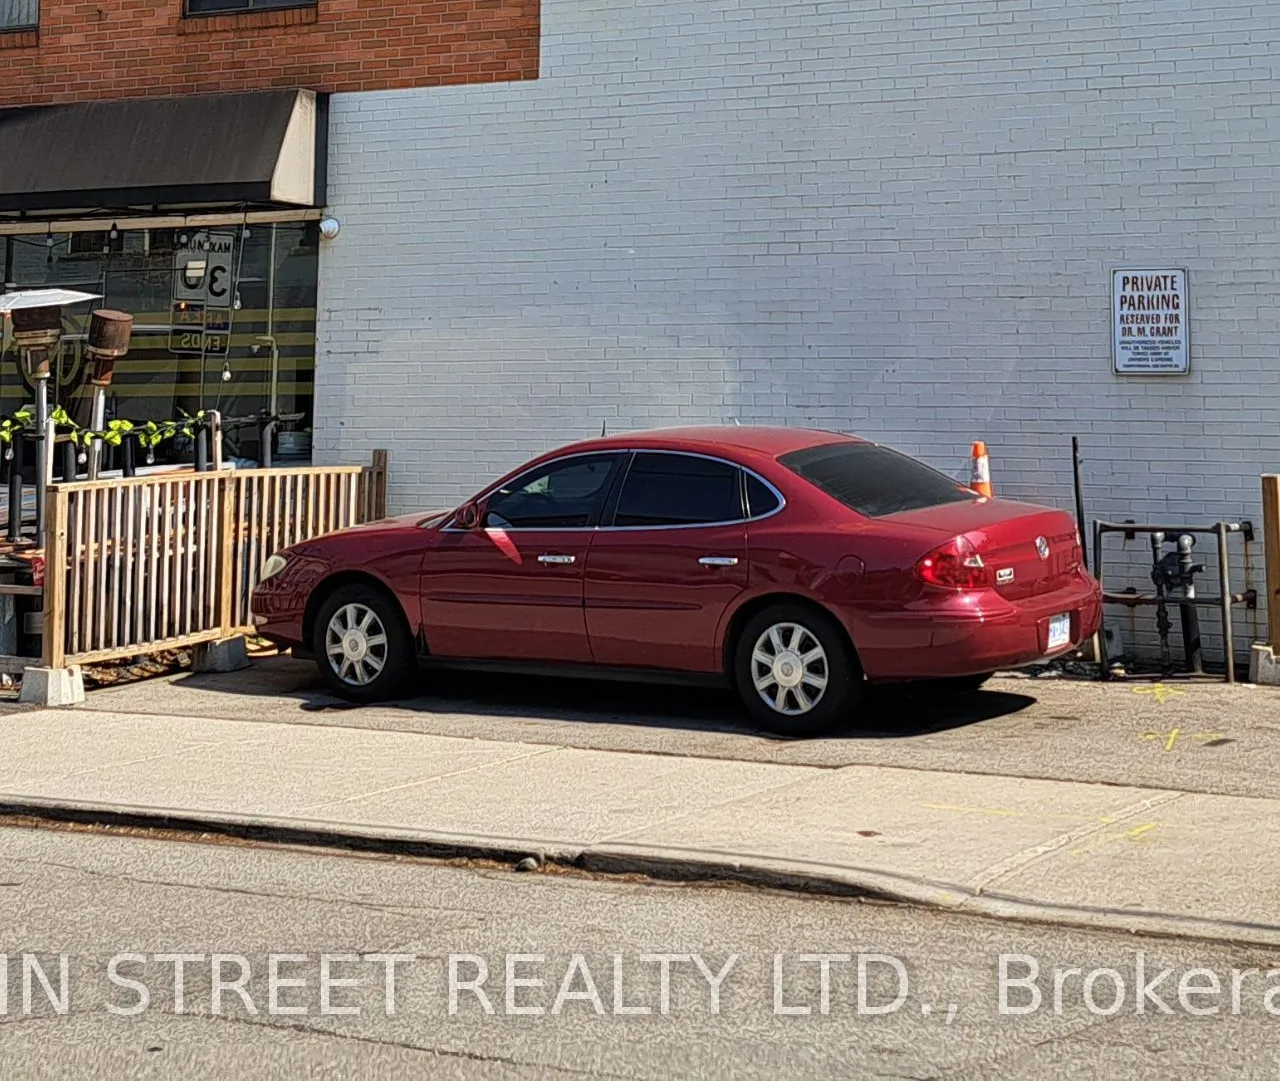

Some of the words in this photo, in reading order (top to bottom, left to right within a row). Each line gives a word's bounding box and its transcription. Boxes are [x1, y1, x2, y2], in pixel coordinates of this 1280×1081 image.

[1122, 275, 1177, 292] PRIVATE
[1120, 294, 1180, 311] PARKING
[1120, 313, 1161, 324] RESERVED
[1164, 313, 1180, 324] FOR
[1121, 326, 1136, 337] DR.
[1137, 326, 1148, 337] M.
[1149, 326, 1179, 337] GRANT
